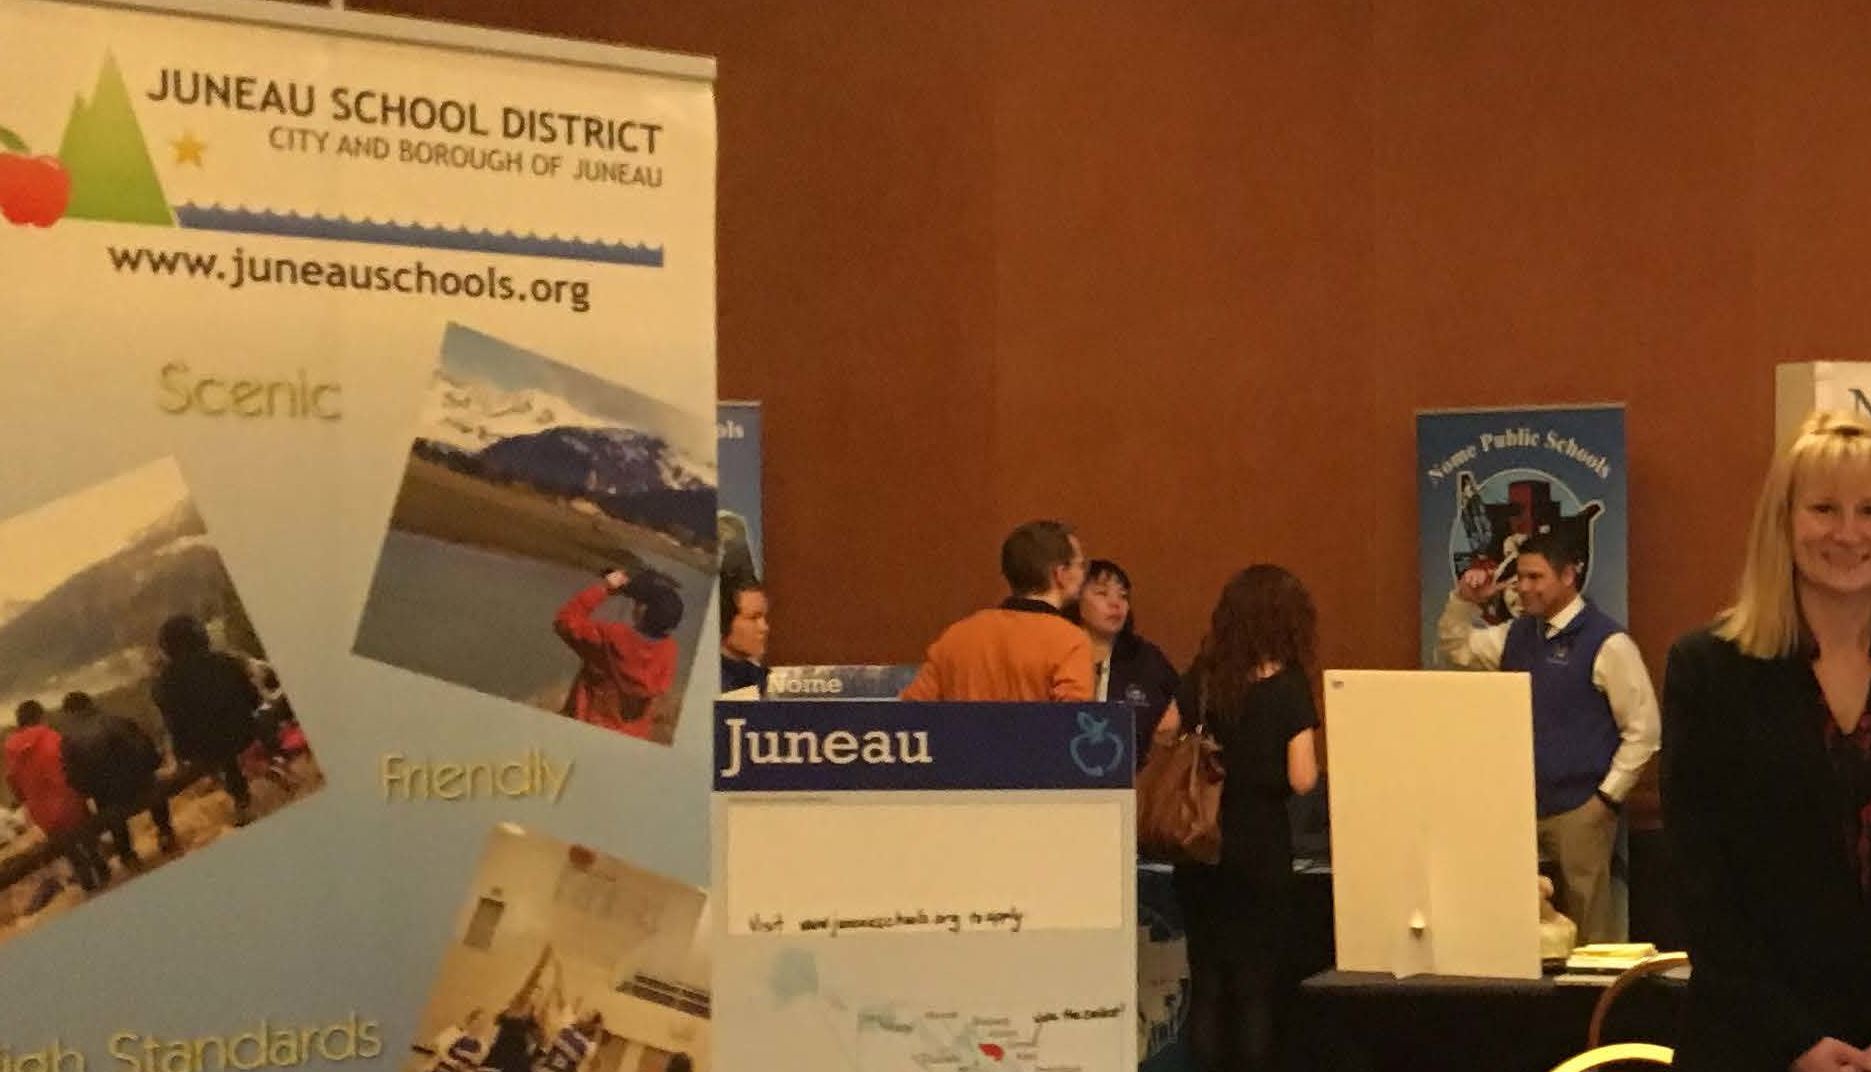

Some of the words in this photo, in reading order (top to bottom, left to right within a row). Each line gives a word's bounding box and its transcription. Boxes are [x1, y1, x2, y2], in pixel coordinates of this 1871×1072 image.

[145, 69, 315, 116] JUNEAU
[333, 88, 487, 136] SCHOOL
[503, 108, 662, 154] DISTRICT
[269, 127, 330, 153] CITY
[337, 134, 388, 159] AND
[400, 139, 523, 173] BOROUGH
[531, 152, 560, 177] OF
[574, 157, 663, 187] JUNEAU
[108, 243, 589, 310] www.juneauschools.org
[157, 363, 342, 420] Scenic
[1428, 445, 1477, 484] Nome
[1480, 428, 1540, 452] Public
[1545, 430, 1611, 479] Schools
[767, 672, 842, 694] Nome
[381, 749, 574, 802] Friendly
[721, 719, 933, 778] Juneau
